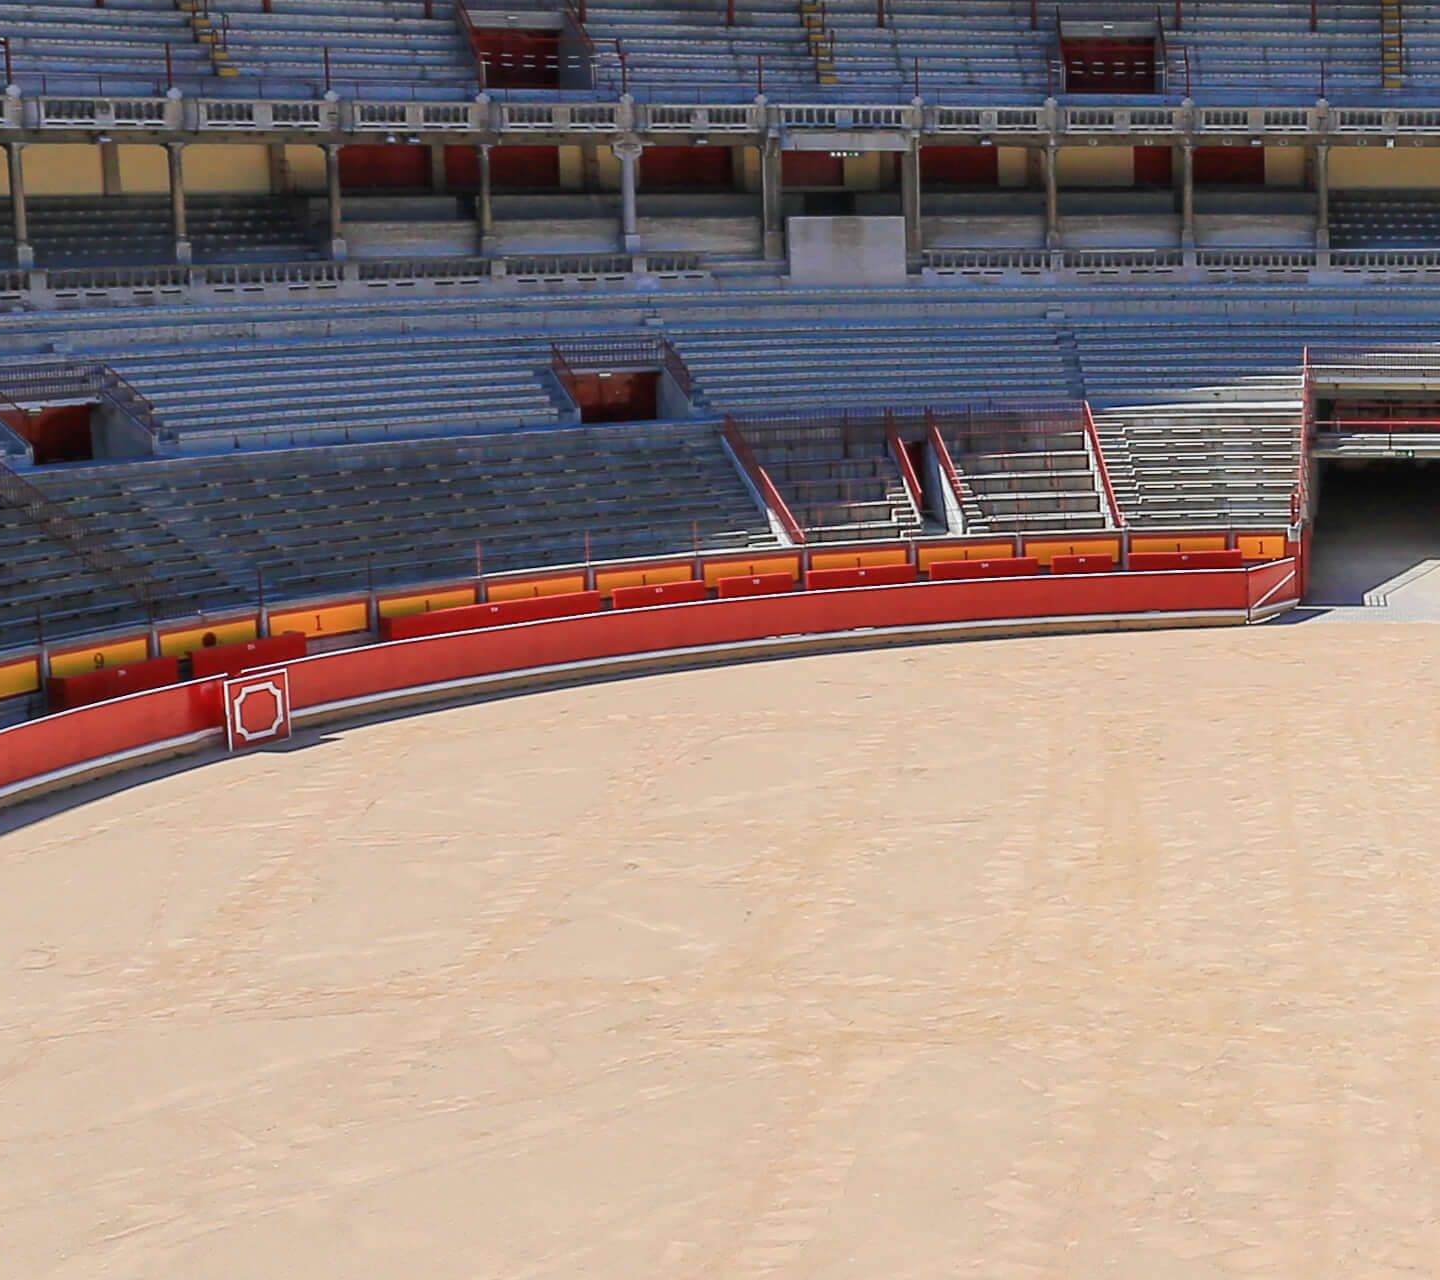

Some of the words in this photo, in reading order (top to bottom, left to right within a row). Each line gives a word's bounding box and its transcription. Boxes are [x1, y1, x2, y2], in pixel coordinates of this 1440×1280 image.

[1068, 546, 1074, 556] 1
[1175, 543, 1181, 553] 1
[1258, 541, 1264, 555] 1
[963, 550, 968, 561] 1
[856, 557, 862, 568] 1
[749, 565, 754, 576] 1
[641, 574, 647, 585] 1
[315, 614, 323, 631] 1
[93, 651, 104, 670] 9
